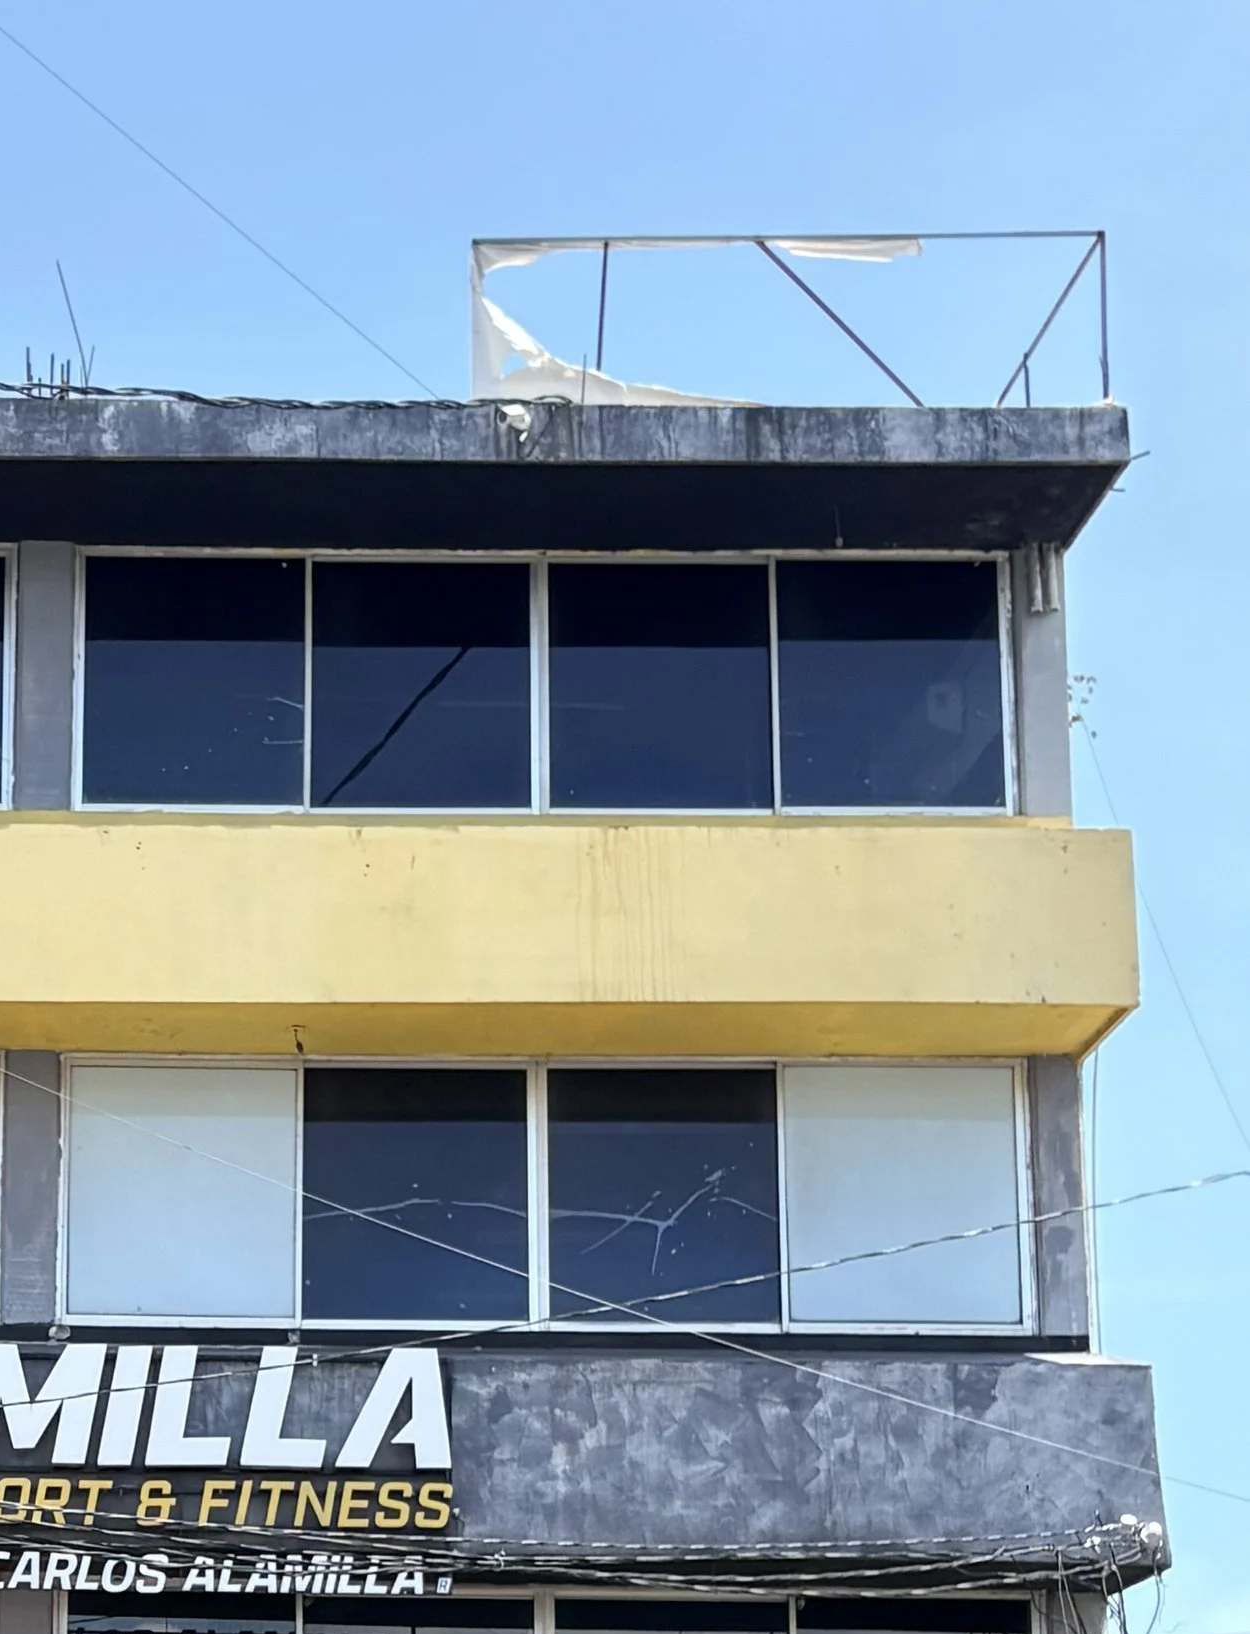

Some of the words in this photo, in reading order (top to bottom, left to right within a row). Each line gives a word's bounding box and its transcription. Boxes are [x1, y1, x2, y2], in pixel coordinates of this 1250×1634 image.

[135, 1479, 177, 1528] &
[197, 1480, 454, 1530] FITNESS
[180, 1553, 424, 1596] ALAMILLA
